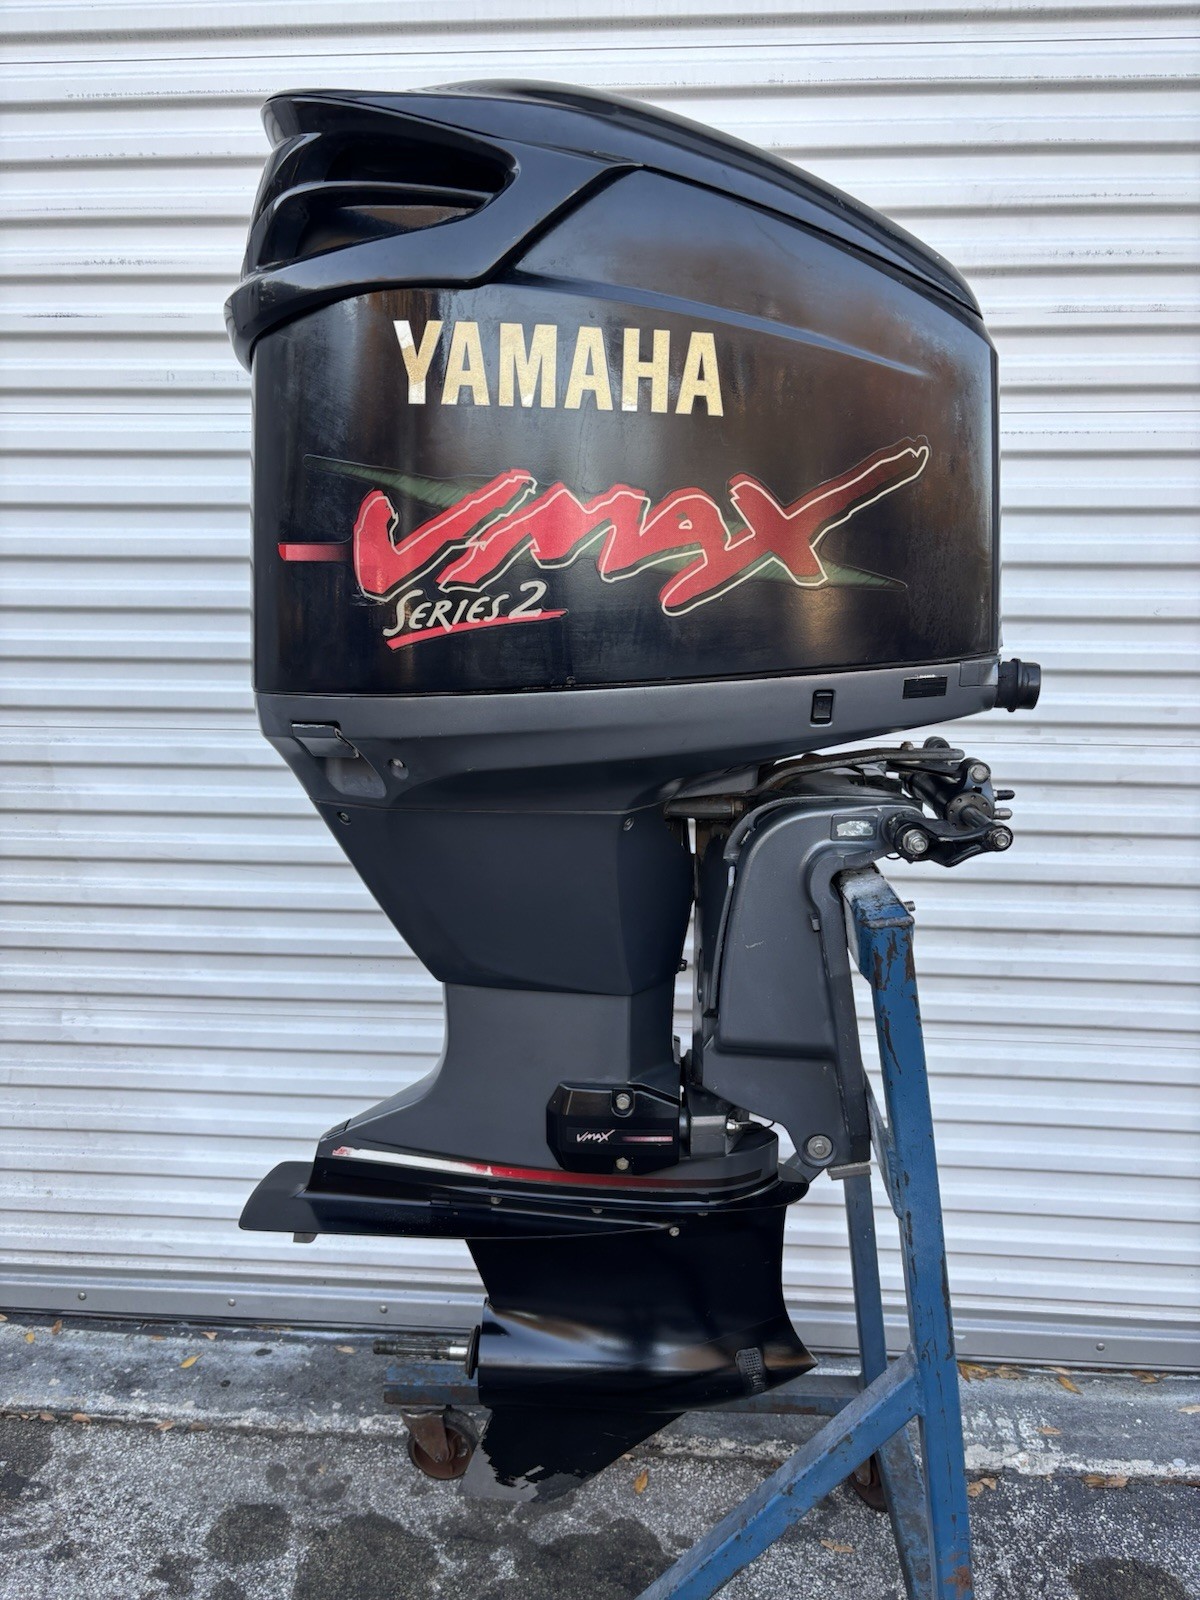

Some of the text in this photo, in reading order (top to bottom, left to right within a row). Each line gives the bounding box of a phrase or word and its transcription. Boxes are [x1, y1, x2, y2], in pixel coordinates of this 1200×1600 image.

[393, 320, 723, 417] YAMAHA
[383, 580, 548, 637] SERIES 2
